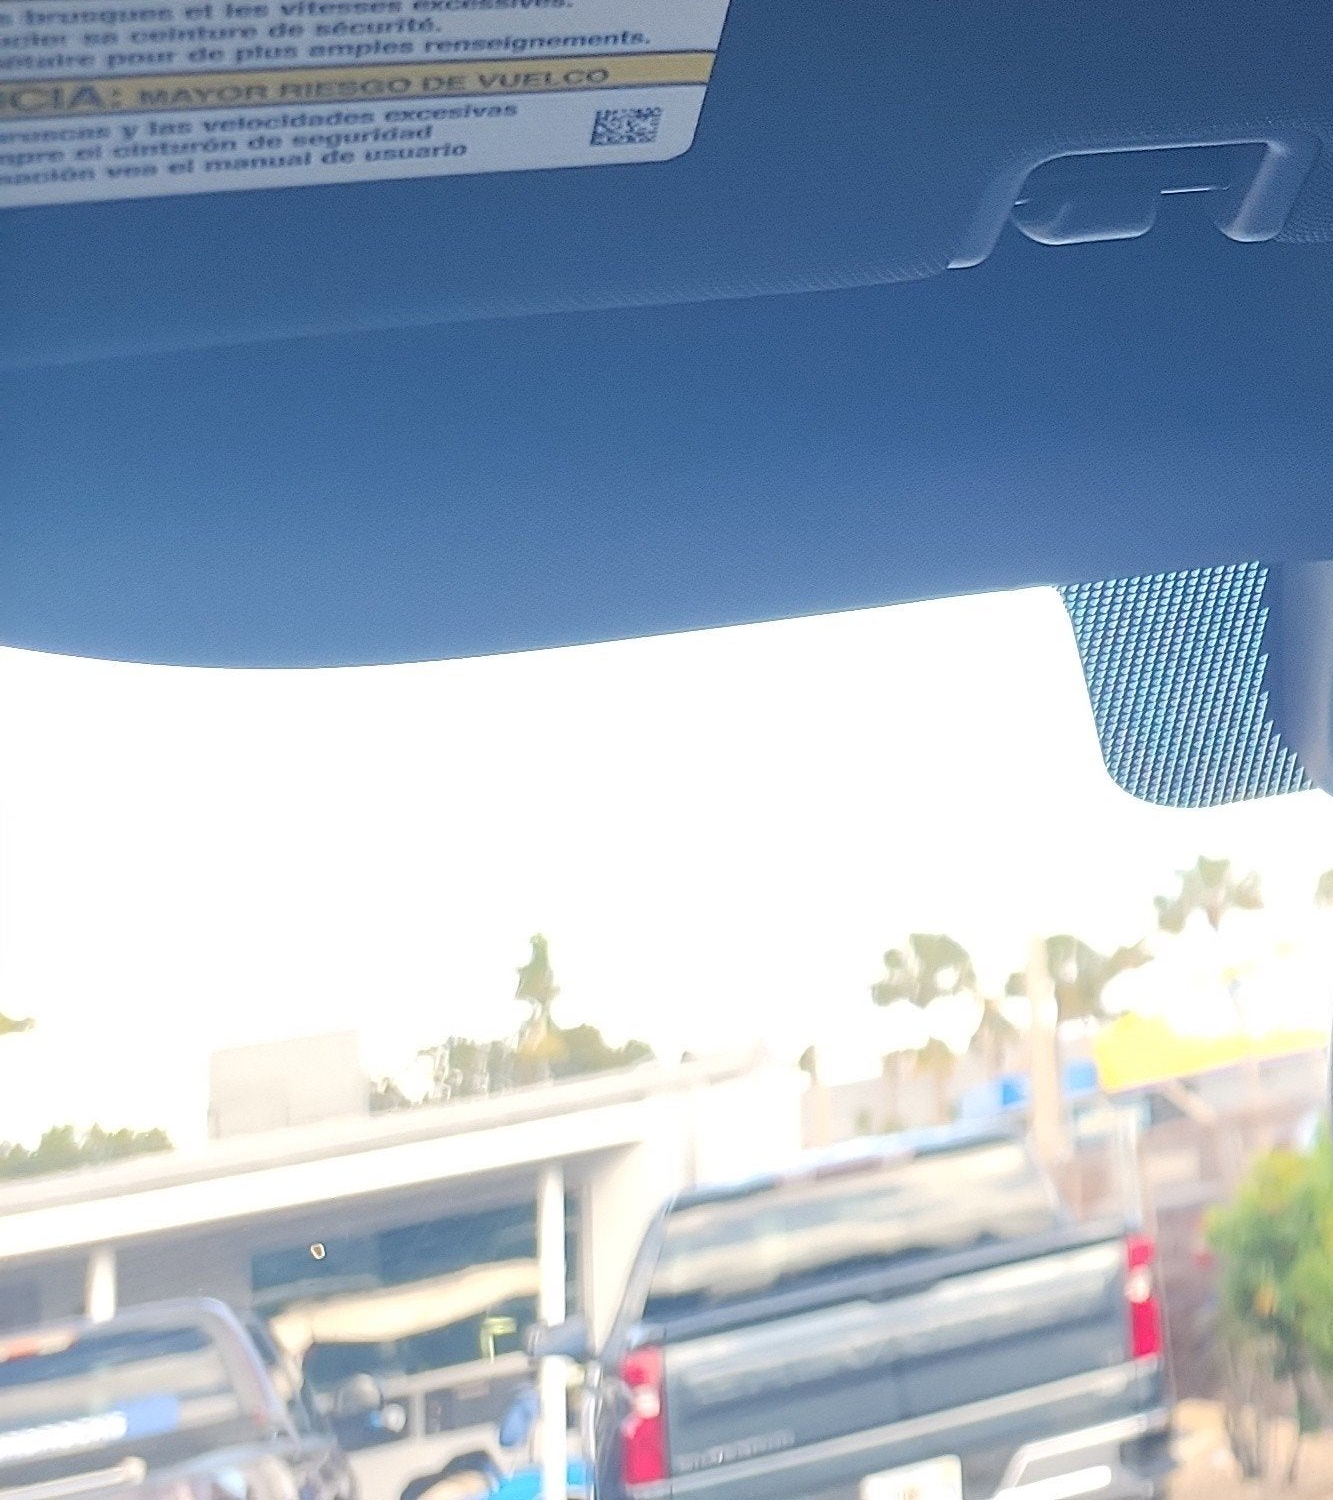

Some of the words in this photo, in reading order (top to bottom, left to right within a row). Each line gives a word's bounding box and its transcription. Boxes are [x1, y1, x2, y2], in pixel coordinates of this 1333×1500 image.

[24, 7, 173, 28] brusques
[185, 3, 213, 19] et
[225, 3, 269, 18] les
[130, 26, 258, 44] ceinture
[268, 23, 304, 39] de
[315, 16, 442, 36] sécurité.
[107, 51, 174, 69] pour
[188, 47, 225, 63] de
[235, 44, 298, 64] plus
[308, 38, 414, 59] amples
[425, 30, 650, 52] renseignements.
[0, 85, 122, 111] CIA:
[138, 83, 268, 103] MAYOR
[280, 77, 411, 98] RIESGO
[422, 75, 466, 92] DE
[479, 68, 610, 88] VUELCO
[122, 124, 139, 140] y
[148, 120, 193, 136] las
[203, 112, 375, 133] velocidades
[385, 104, 518, 122] excesivas
[75, 144, 102, 161] el
[114, 136, 237, 157] cinturón
[249, 133, 282, 150] de
[291, 125, 433, 150] seguridad
[168, 159, 195, 175] el
[204, 151, 312, 173] manual
[321, 148, 355, 165] de
[365, 142, 468, 162] usuario
